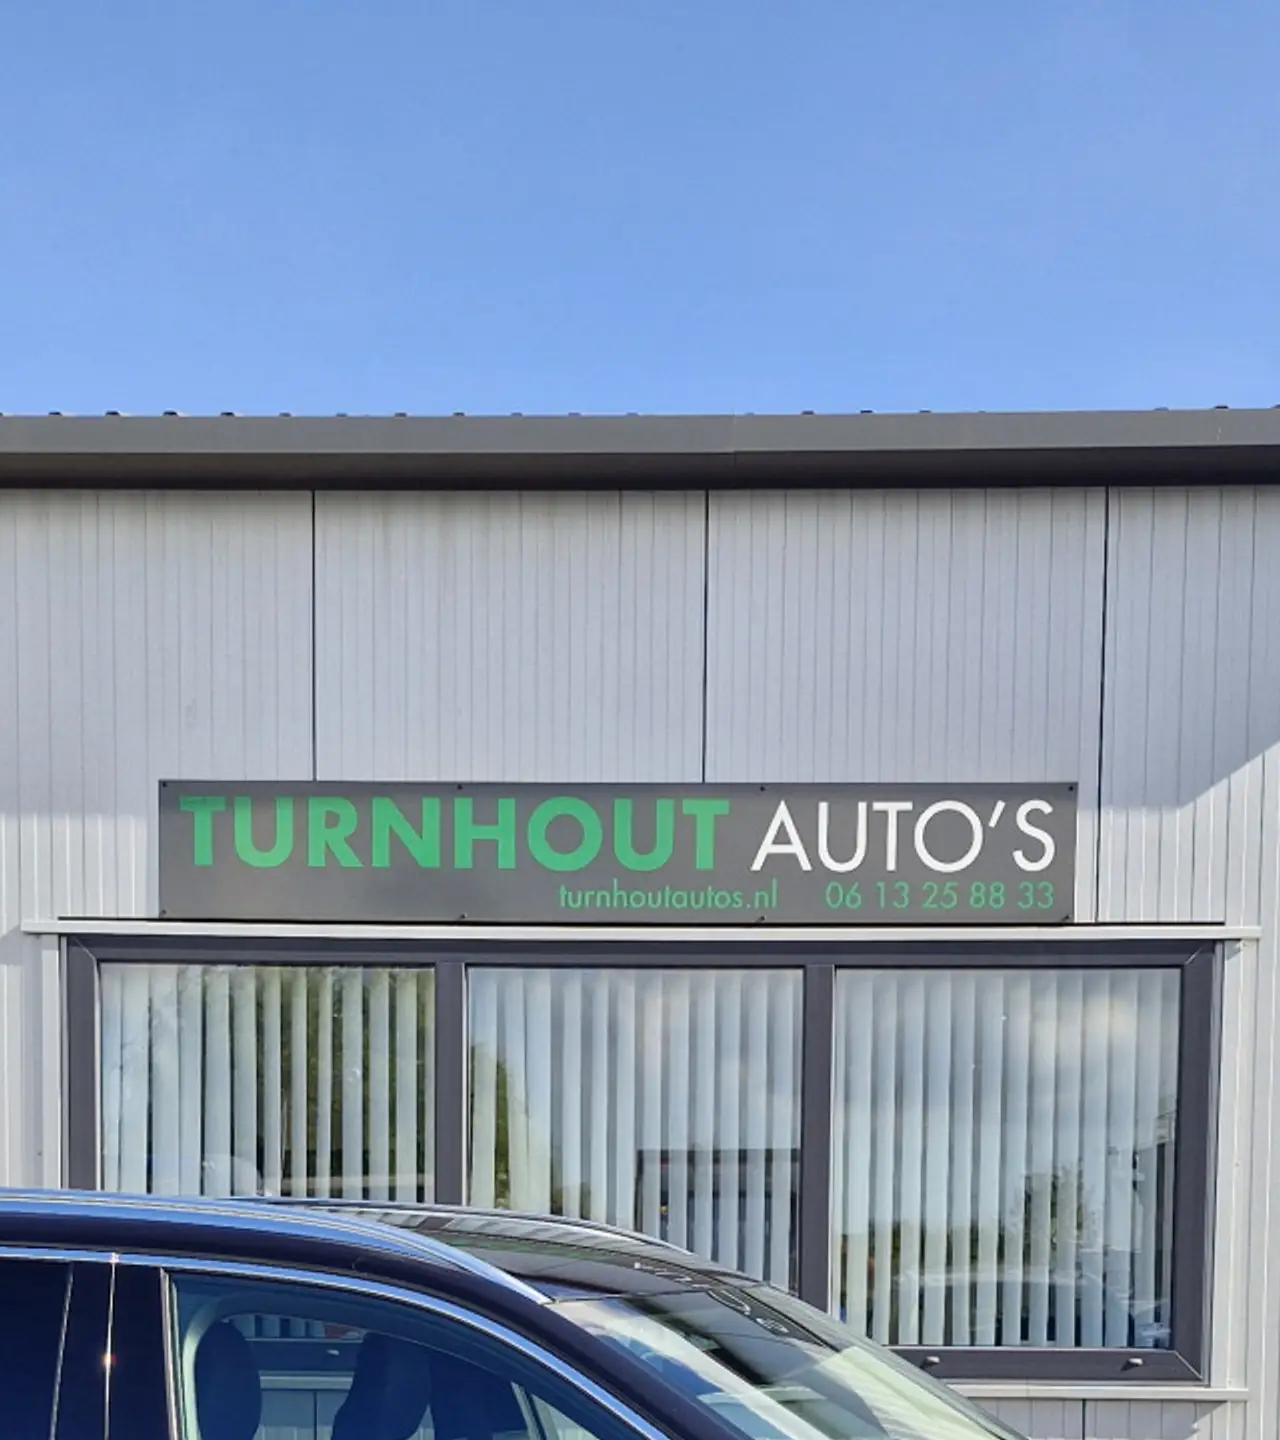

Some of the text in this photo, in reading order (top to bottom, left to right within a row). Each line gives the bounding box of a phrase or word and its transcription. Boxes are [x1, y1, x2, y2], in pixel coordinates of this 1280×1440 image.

[179, 796, 1055, 872] TURNHOUT AUTO'S
[559, 878, 778, 909] turnhoutautos.nl
[825, 881, 1054, 909] 06 13 25 88 33
